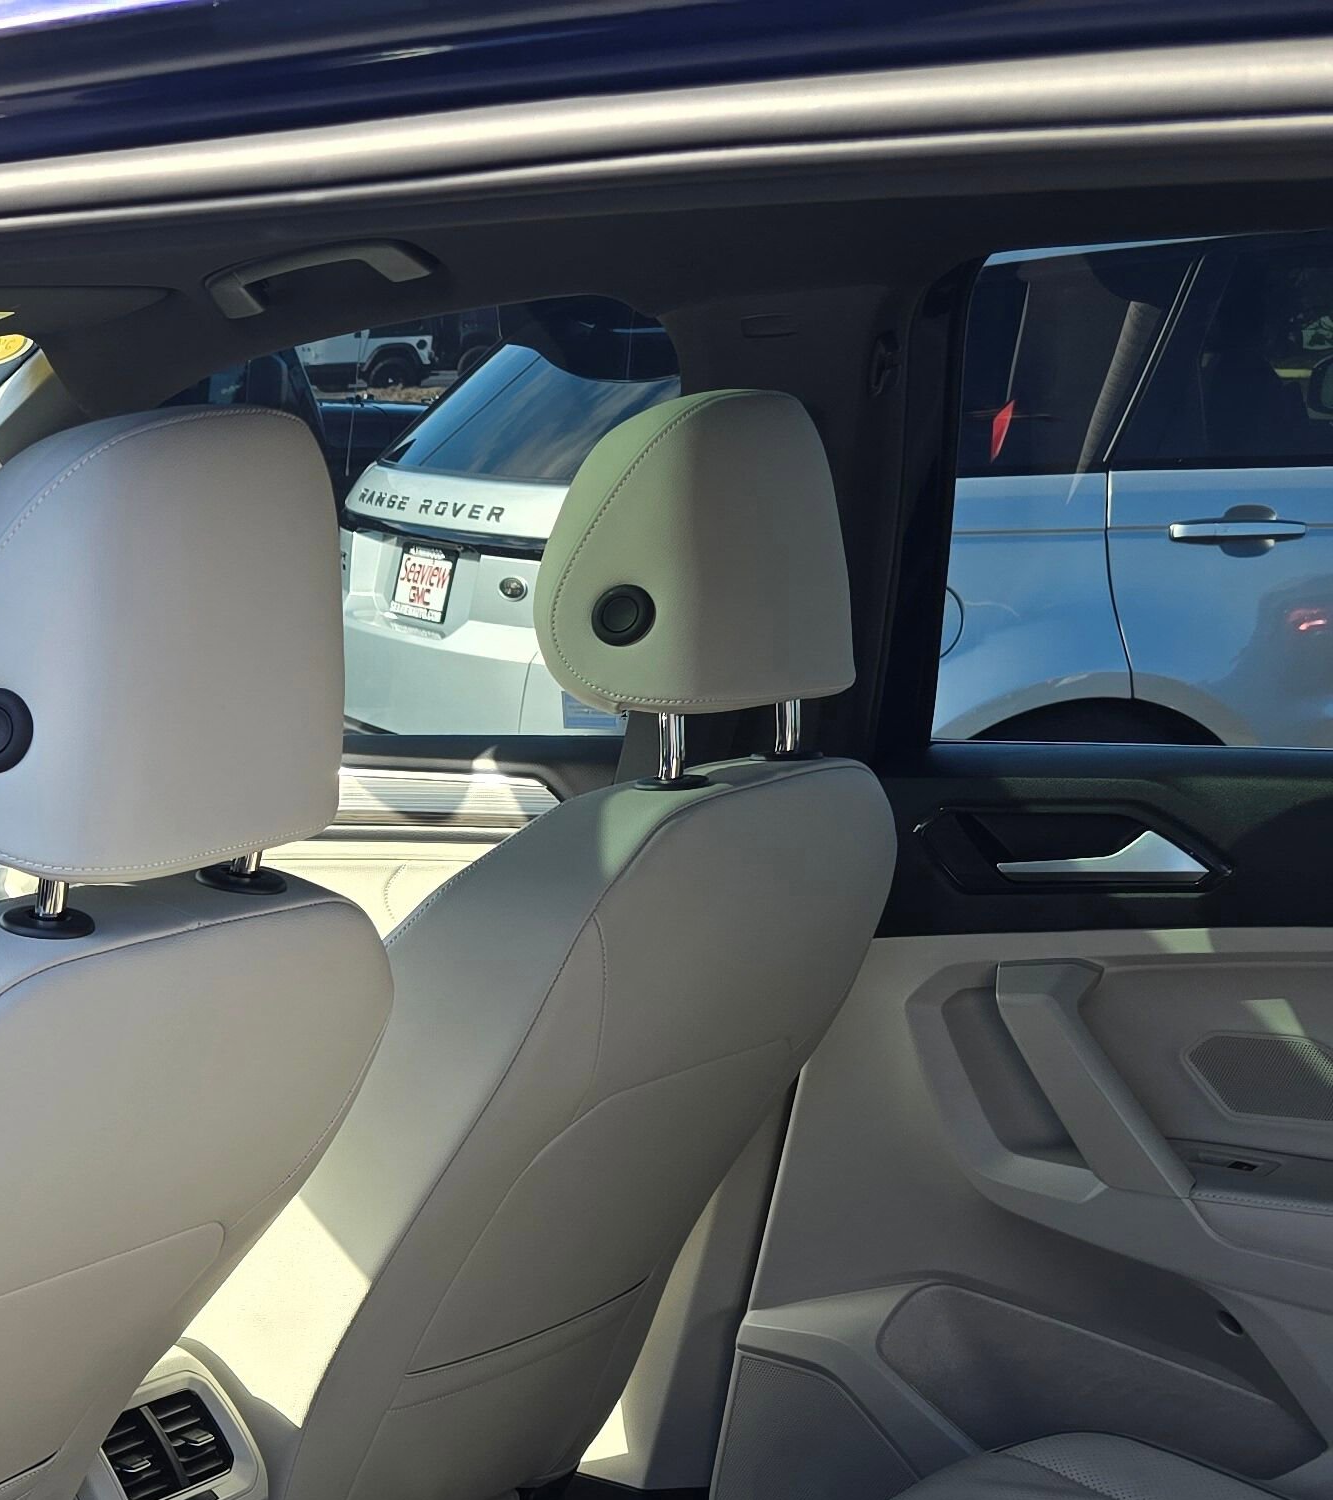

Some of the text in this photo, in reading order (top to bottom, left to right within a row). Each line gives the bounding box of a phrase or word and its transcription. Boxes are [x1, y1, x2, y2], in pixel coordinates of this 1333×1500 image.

[358, 487, 506, 523] RANGE ROVER
[400, 557, 450, 589] Seaview
[409, 586, 431, 606] GMC
